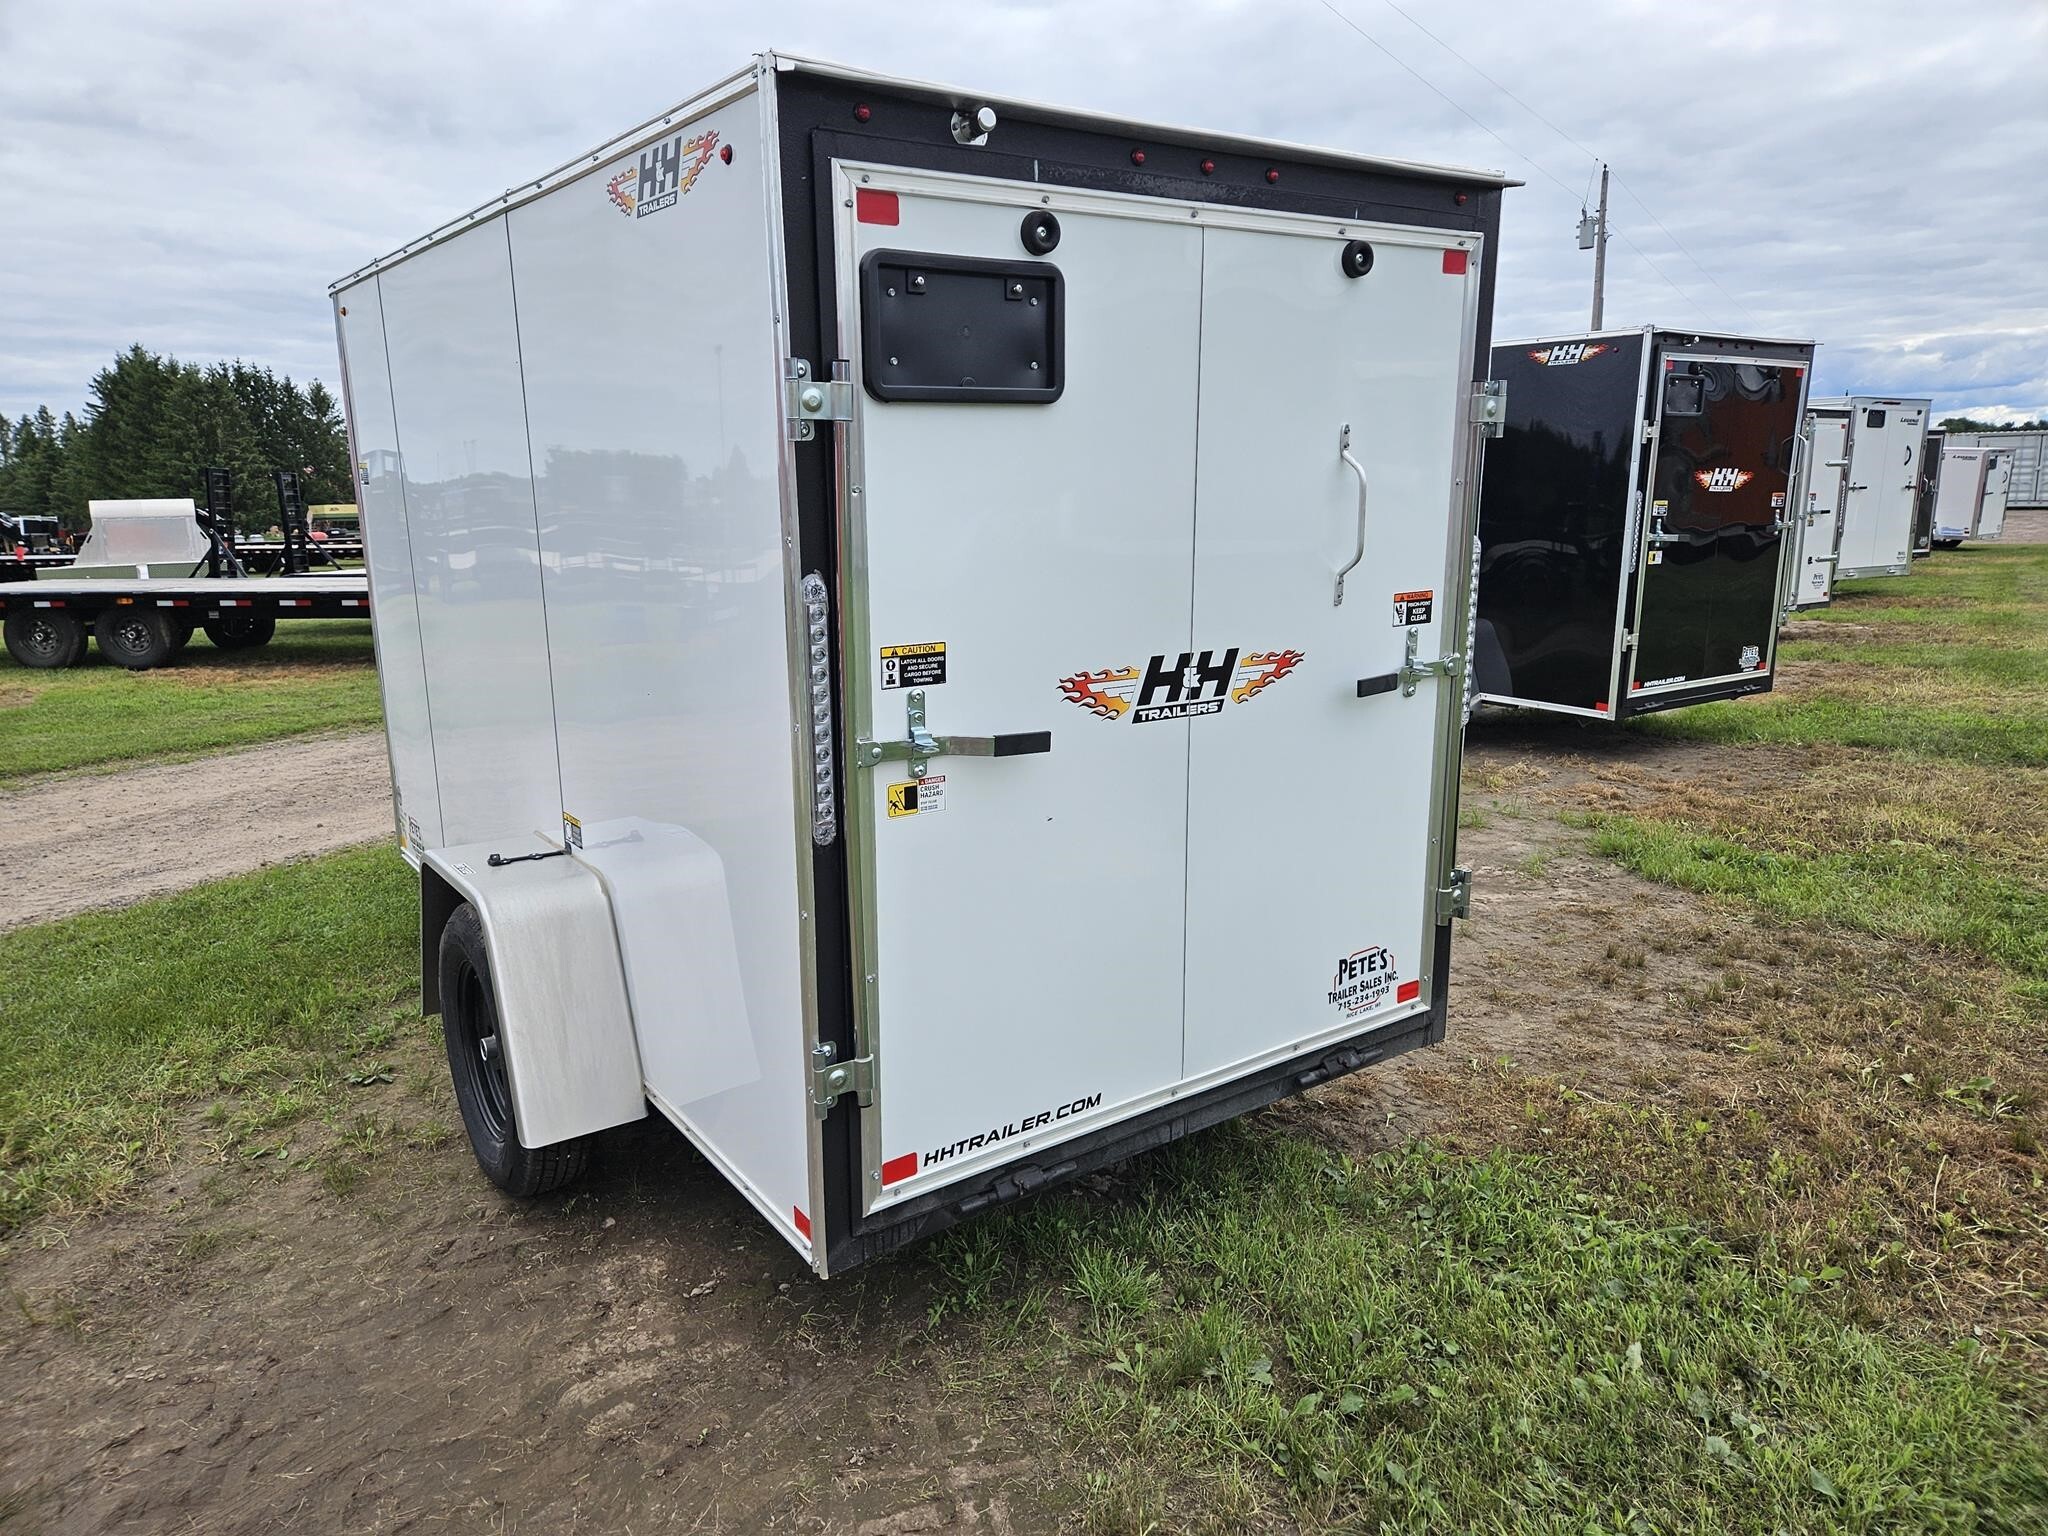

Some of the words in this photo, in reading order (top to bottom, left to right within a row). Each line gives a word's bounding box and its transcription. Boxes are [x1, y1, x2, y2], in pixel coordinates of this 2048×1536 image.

[637, 135, 682, 203] H&H
[638, 193, 677, 216] TRAILERS
[1410, 614, 1427, 622] CLEAR
[1412, 607, 1426, 615] KEEP
[901, 645, 936, 655] CAUTION
[1136, 647, 1240, 707] H&H
[1138, 701, 1220, 722] TRAILERS
[920, 784, 940, 793] CRUSH
[924, 776, 945, 785] DANGER
[920, 789, 944, 799] HAZARD
[1338, 948, 1388, 986] PETE'S
[1327, 984, 1358, 1005] TRAILER
[1359, 975, 1382, 993] SALES
[1384, 970, 1399, 984] INC.
[1338, 985, 1390, 1012] 715-234-1993
[923, 1092, 1102, 1167] HHTRAILER.COM
